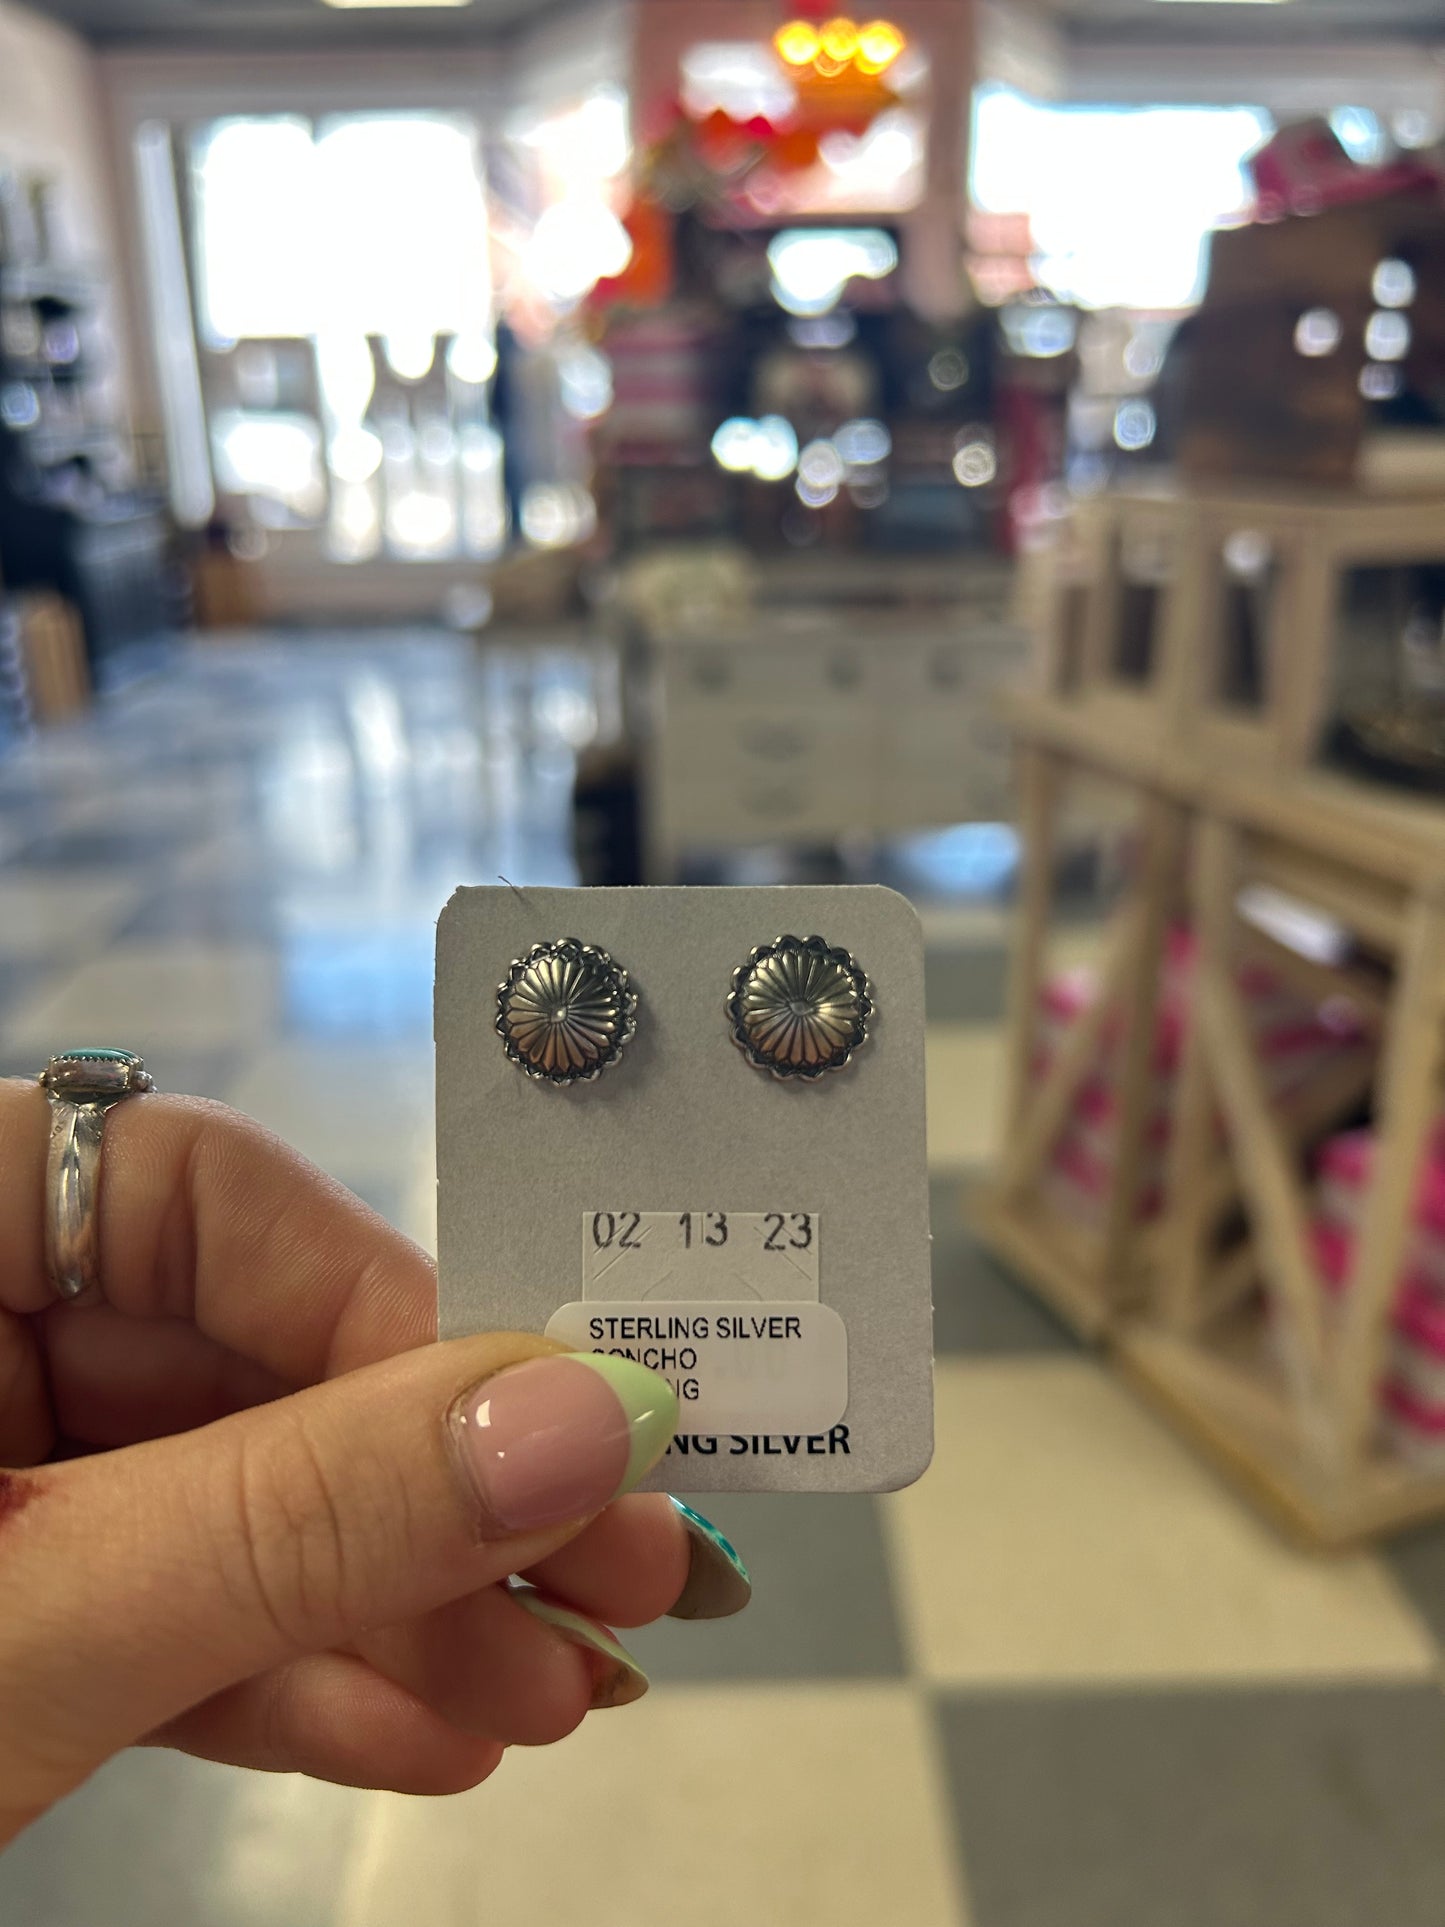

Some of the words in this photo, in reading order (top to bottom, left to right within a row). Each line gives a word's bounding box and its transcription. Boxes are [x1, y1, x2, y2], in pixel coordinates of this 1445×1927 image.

[592, 1212, 642, 1248] 02
[679, 1212, 728, 1249] 13
[764, 1213, 812, 1250] 23
[590, 1317, 709, 1339] STERLING
[717, 1317, 802, 1339] SILVER
[729, 1424, 851, 1455] SILVER
